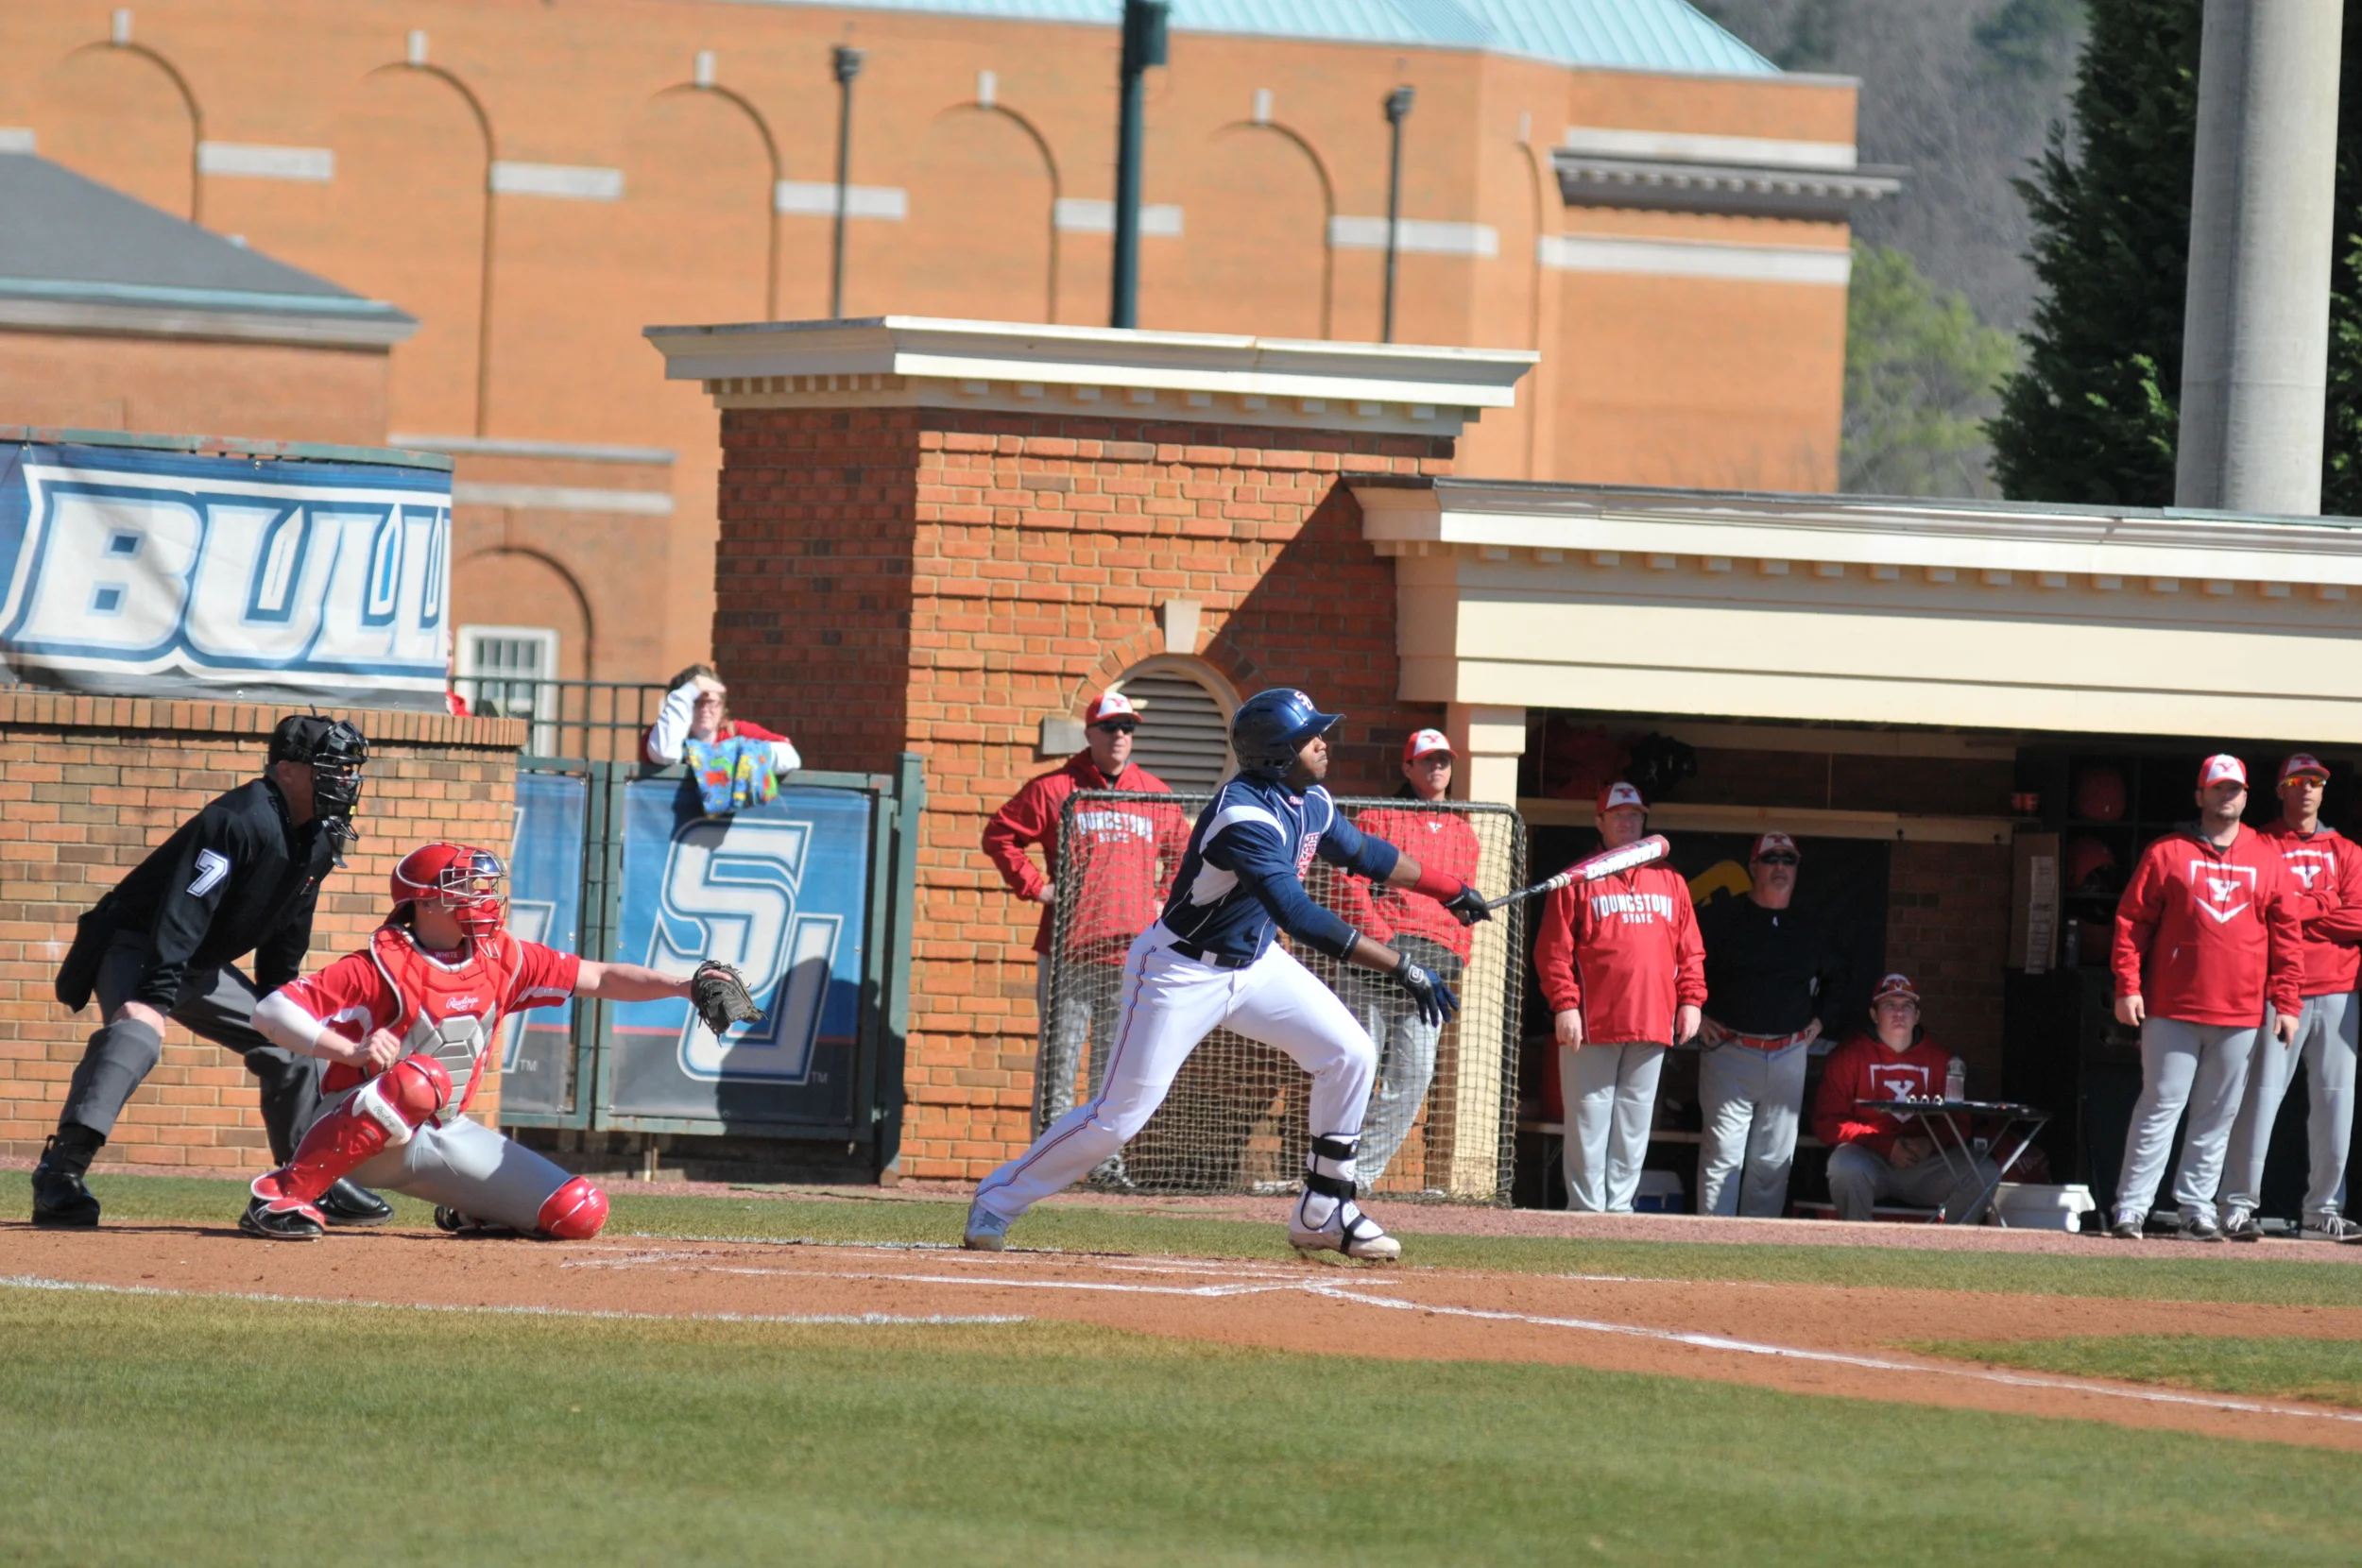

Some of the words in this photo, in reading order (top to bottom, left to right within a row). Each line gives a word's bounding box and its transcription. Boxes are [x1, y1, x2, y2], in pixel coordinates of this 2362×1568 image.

[186, 848, 229, 897] 7
[1622, 912, 1653, 924] STATE
[519, 1059, 538, 1072] TM
